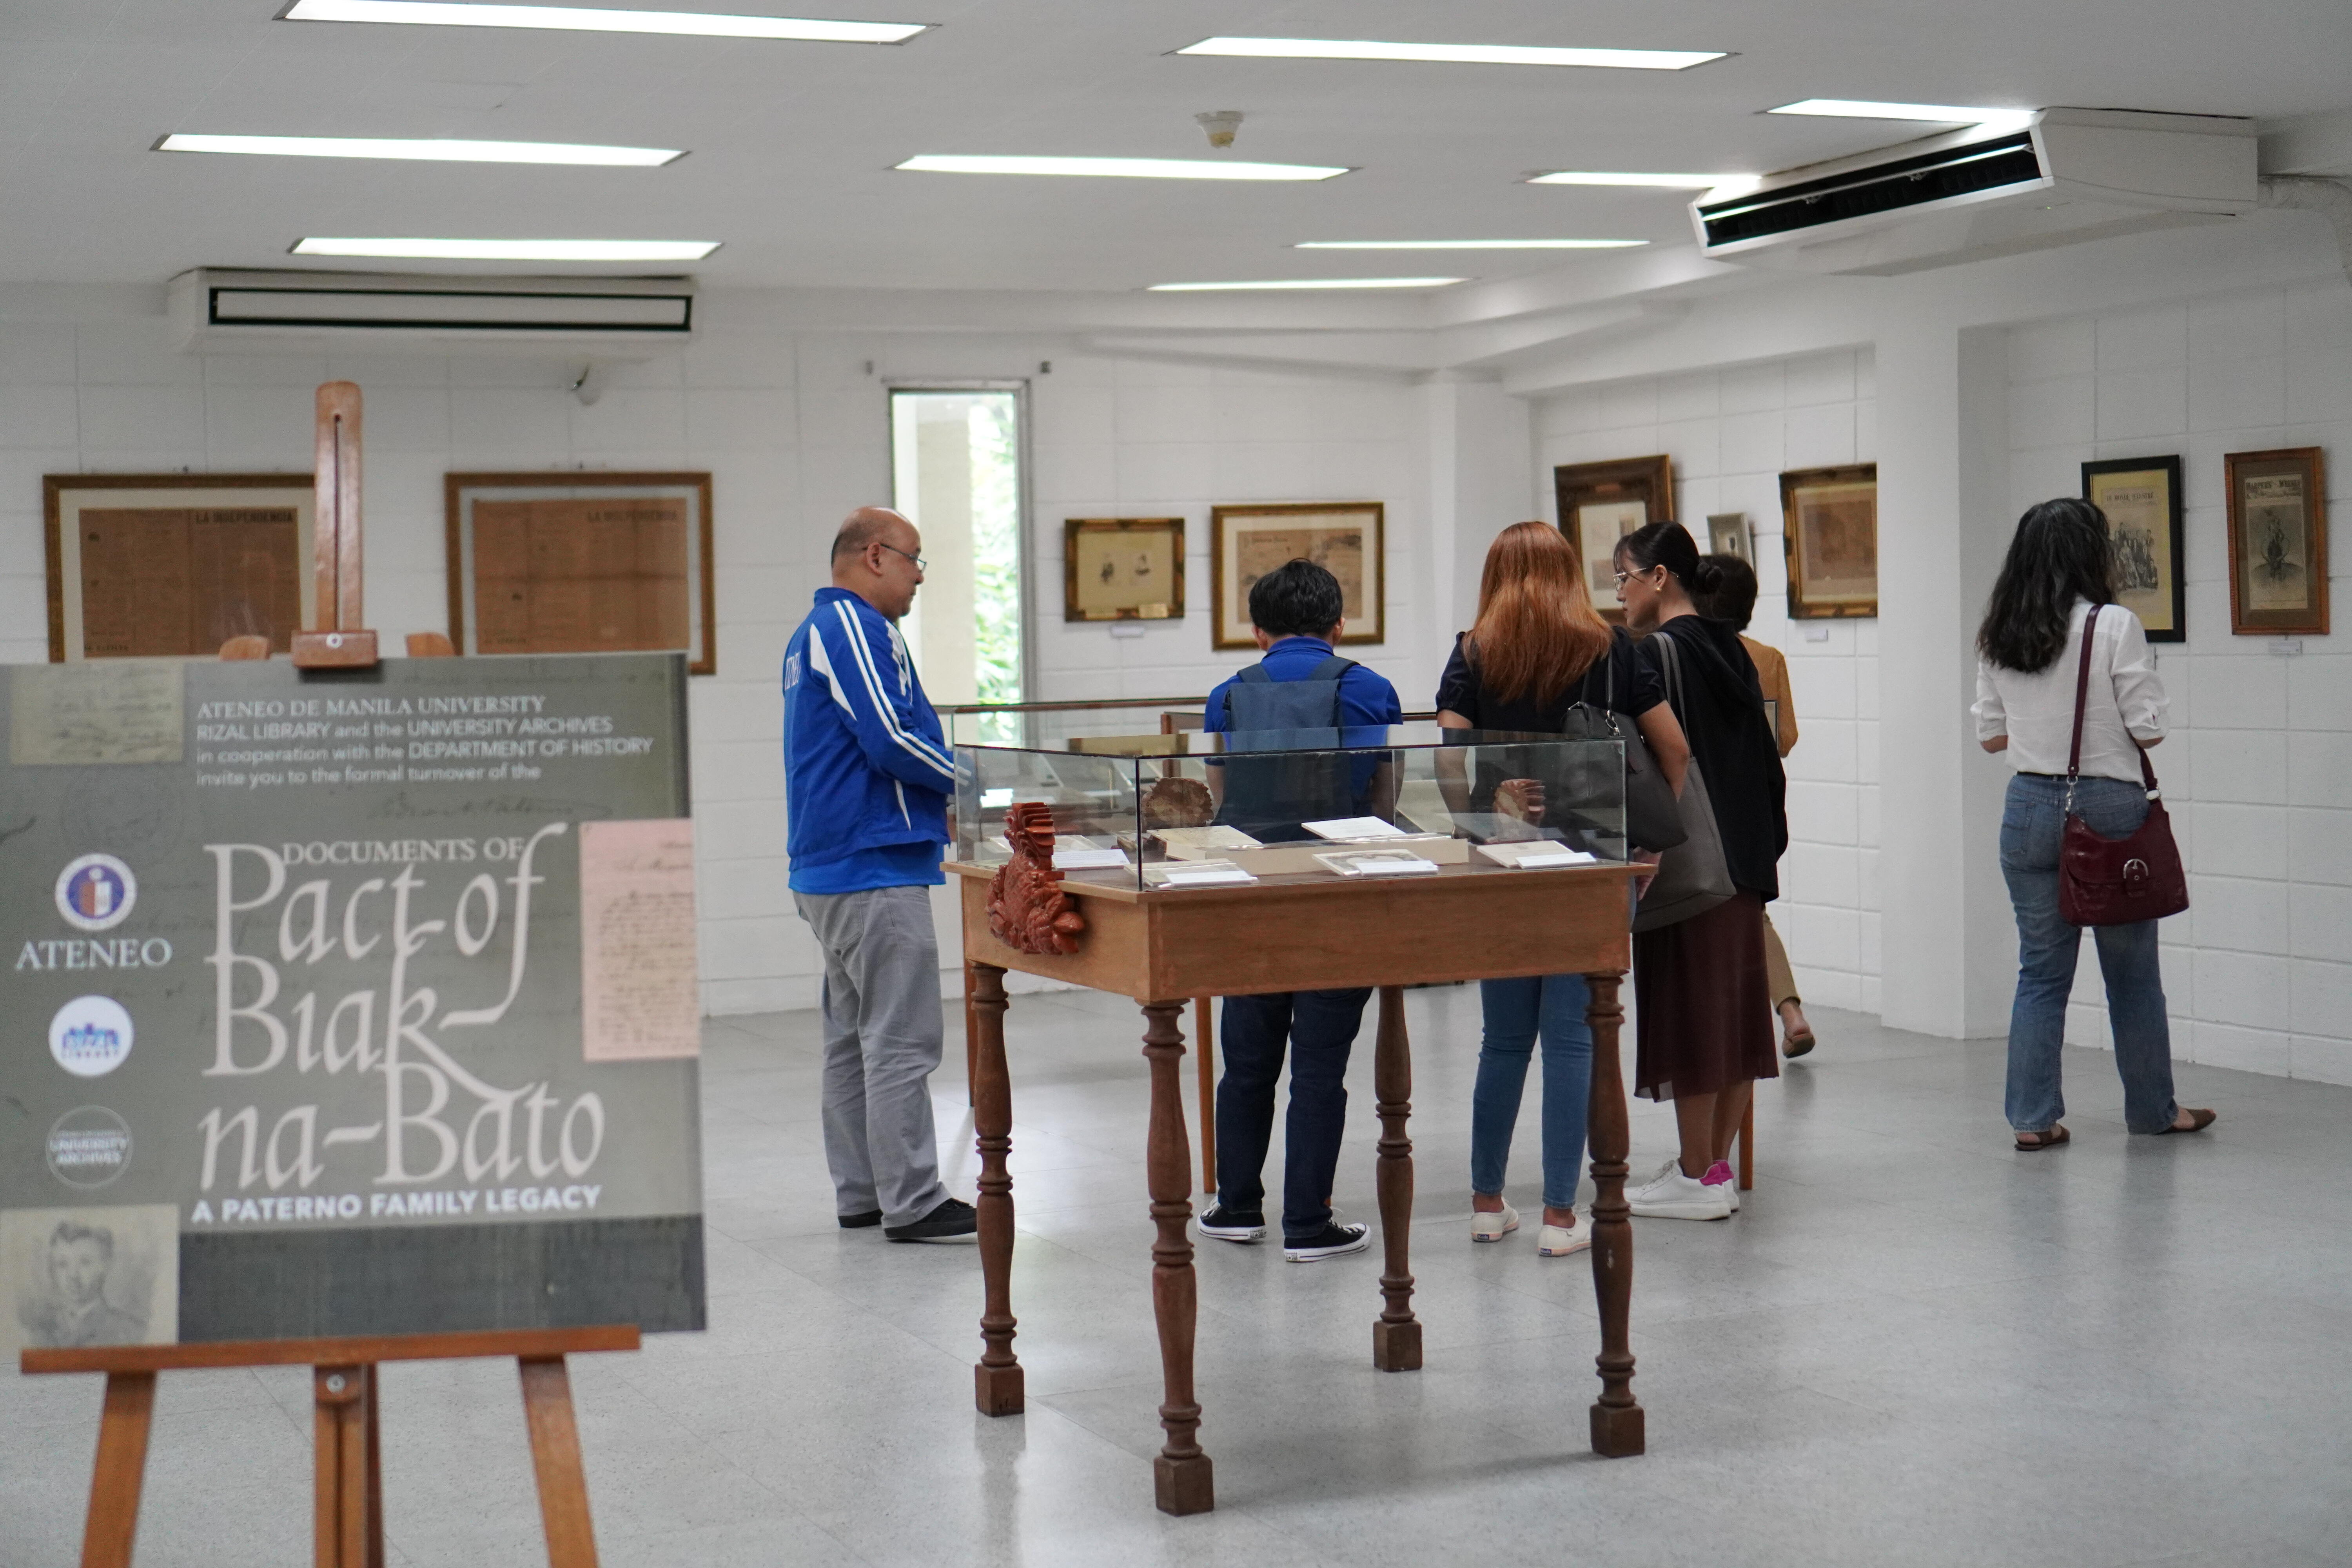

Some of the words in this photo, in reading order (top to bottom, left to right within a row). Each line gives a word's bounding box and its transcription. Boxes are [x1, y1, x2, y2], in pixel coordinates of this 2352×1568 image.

[197, 700, 285, 719] ATENEO
[290, 699, 321, 718] DE
[326, 698, 413, 716] MANILA
[418, 695, 546, 714] UNIVERSITY
[197, 724, 250, 740] RIZAL
[253, 722, 332, 740] LIBRARY
[334, 720, 370, 738] and
[374, 719, 404, 737] the
[407, 718, 517, 737] UNIVERSITY
[518, 716, 614, 735] ARCHIVES
[197, 748, 214, 763] in
[218, 745, 329, 767] cooperation
[332, 744, 371, 760] with
[374, 742, 405, 760] the
[408, 739, 538, 759] DEPARTMENT
[540, 737, 568, 757] OF
[572, 735, 655, 757] HISTORY
[197, 769, 247, 786] invite
[249, 771, 285, 791] you
[288, 769, 309, 785] to
[311, 767, 343, 784] the
[345, 765, 405, 782] formal
[408, 767, 485, 782] turnover
[488, 762, 508, 780] of
[511, 762, 542, 780] the
[281, 838, 477, 865] DOCUMENTS
[483, 837, 524, 860] OF
[15, 938, 173, 971] ATENEO
[191, 1198, 214, 1224] A
[221, 1194, 363, 1223] PATERNO
[370, 1189, 479, 1217] FAMILY
[485, 1184, 603, 1213] LEGACY
